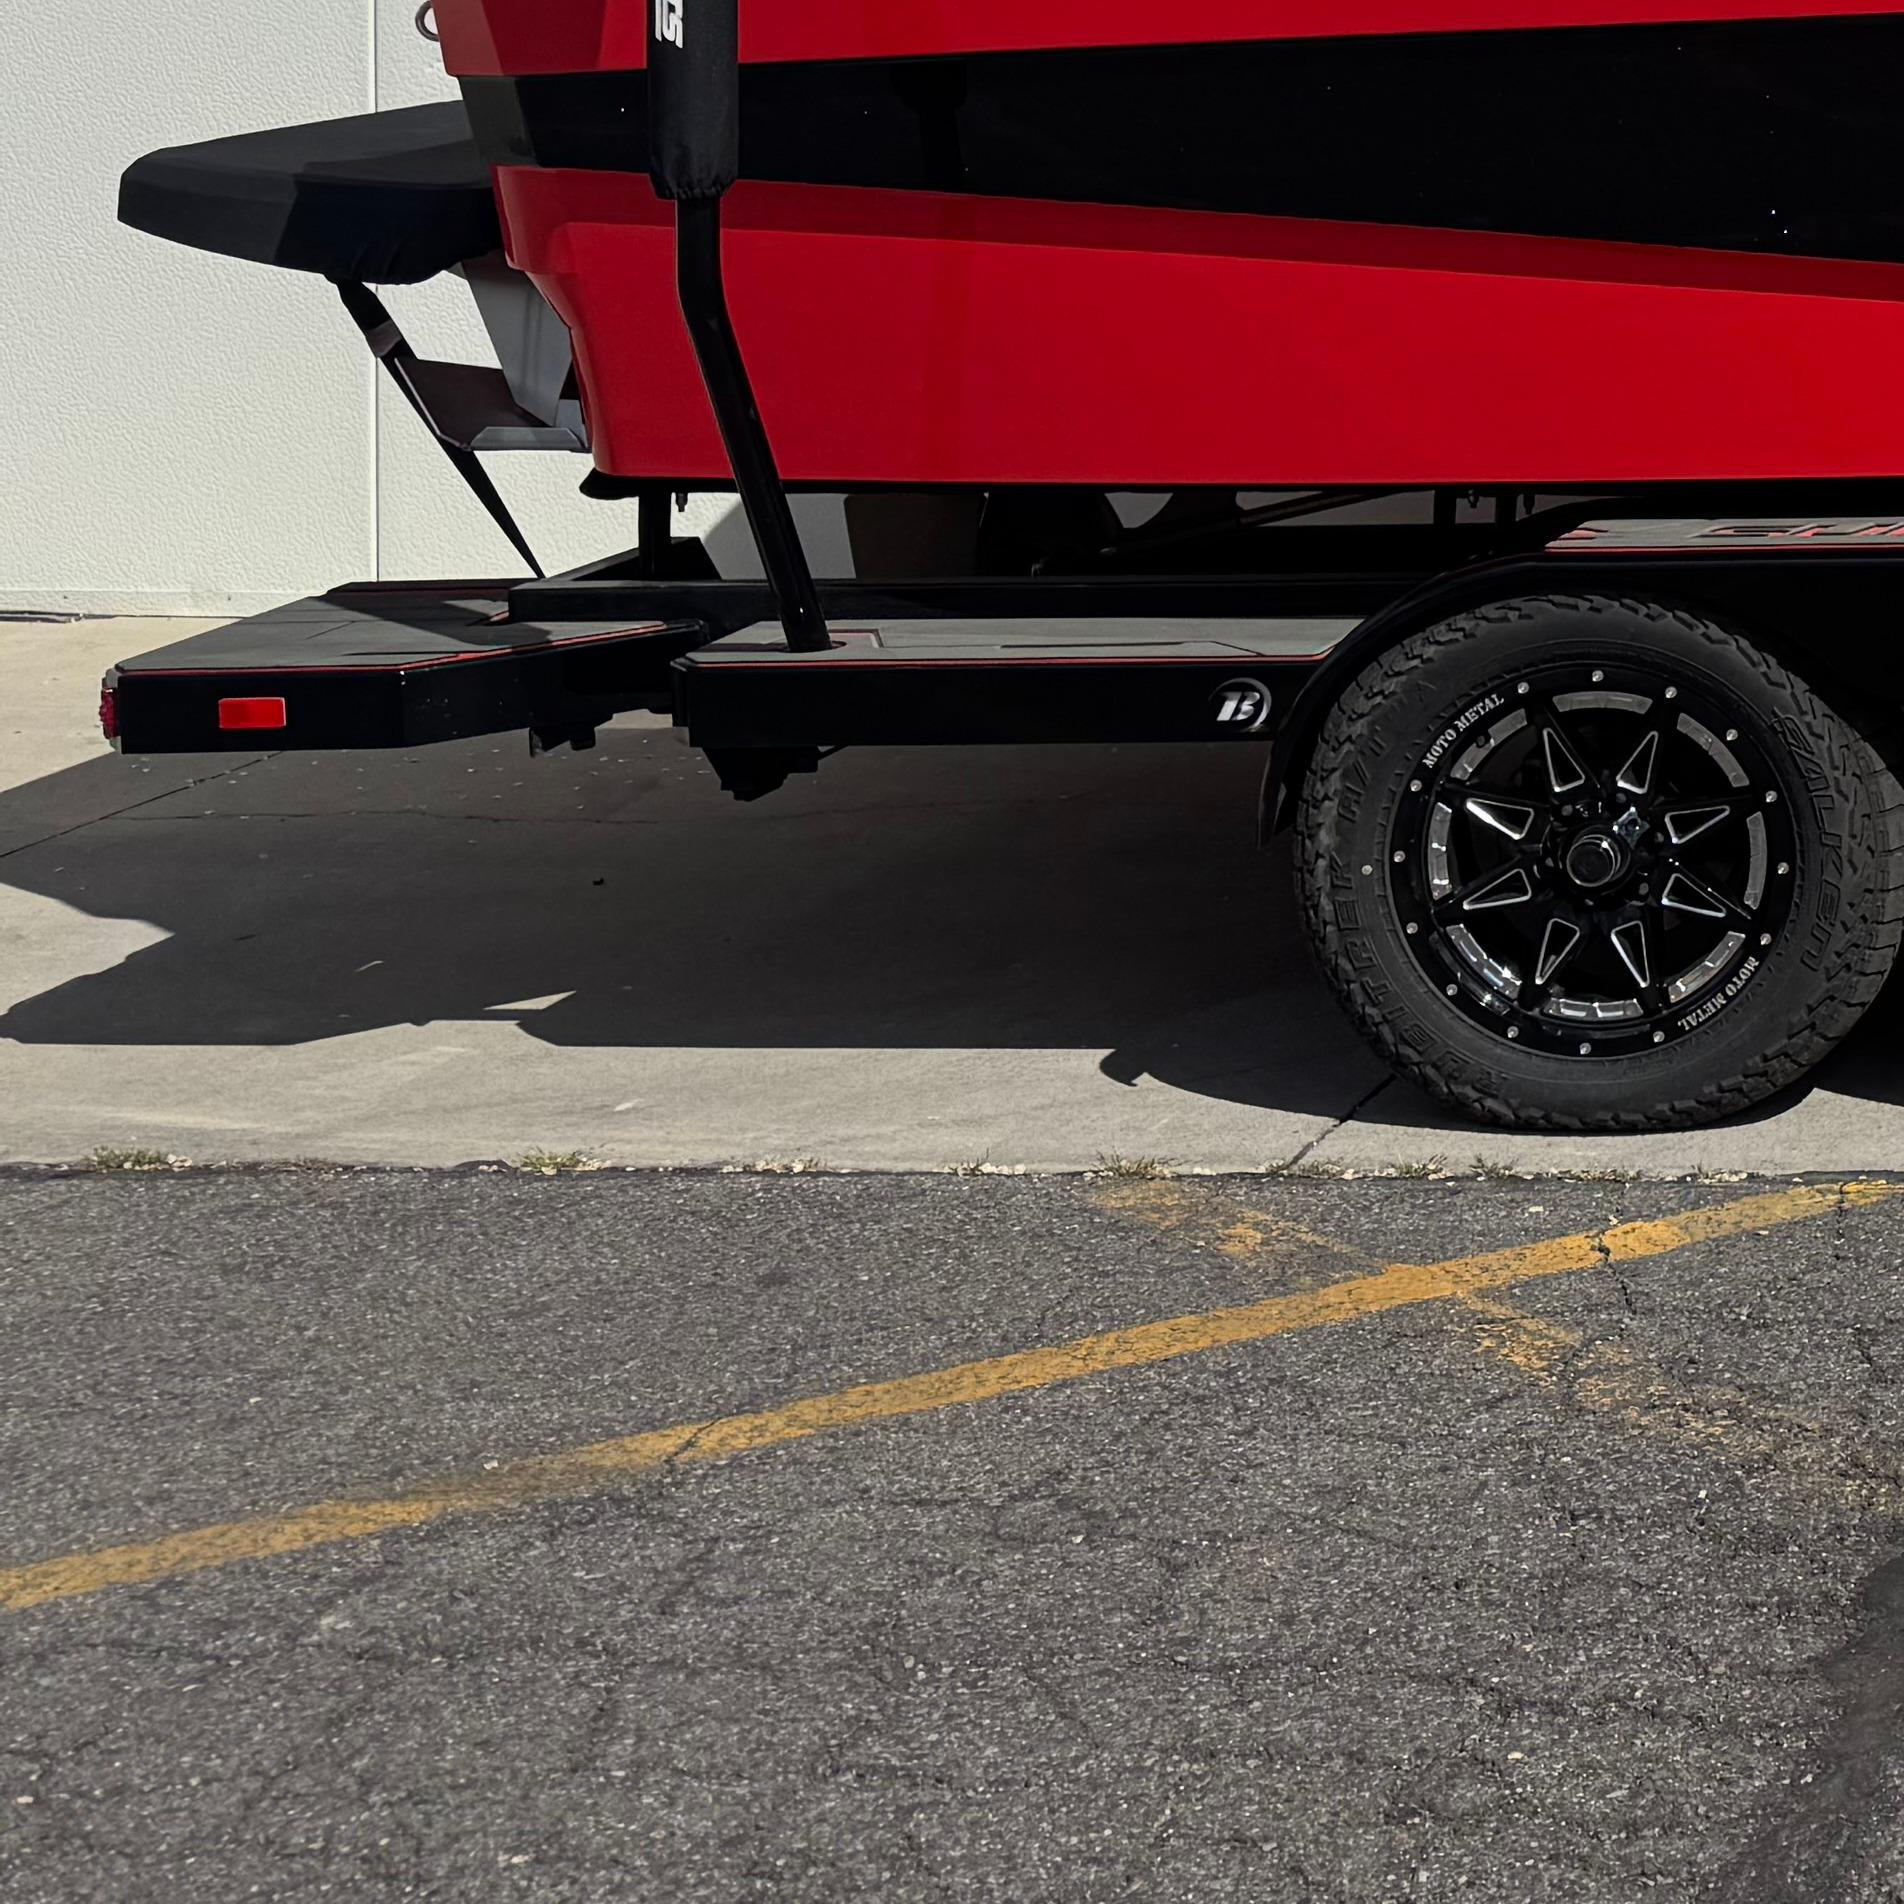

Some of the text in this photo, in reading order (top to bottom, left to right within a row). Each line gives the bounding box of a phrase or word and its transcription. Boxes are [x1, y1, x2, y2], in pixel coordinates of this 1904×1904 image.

[1421, 692, 1506, 770] MOTO METAL
[1677, 956, 1761, 1033] MOTO METAL
